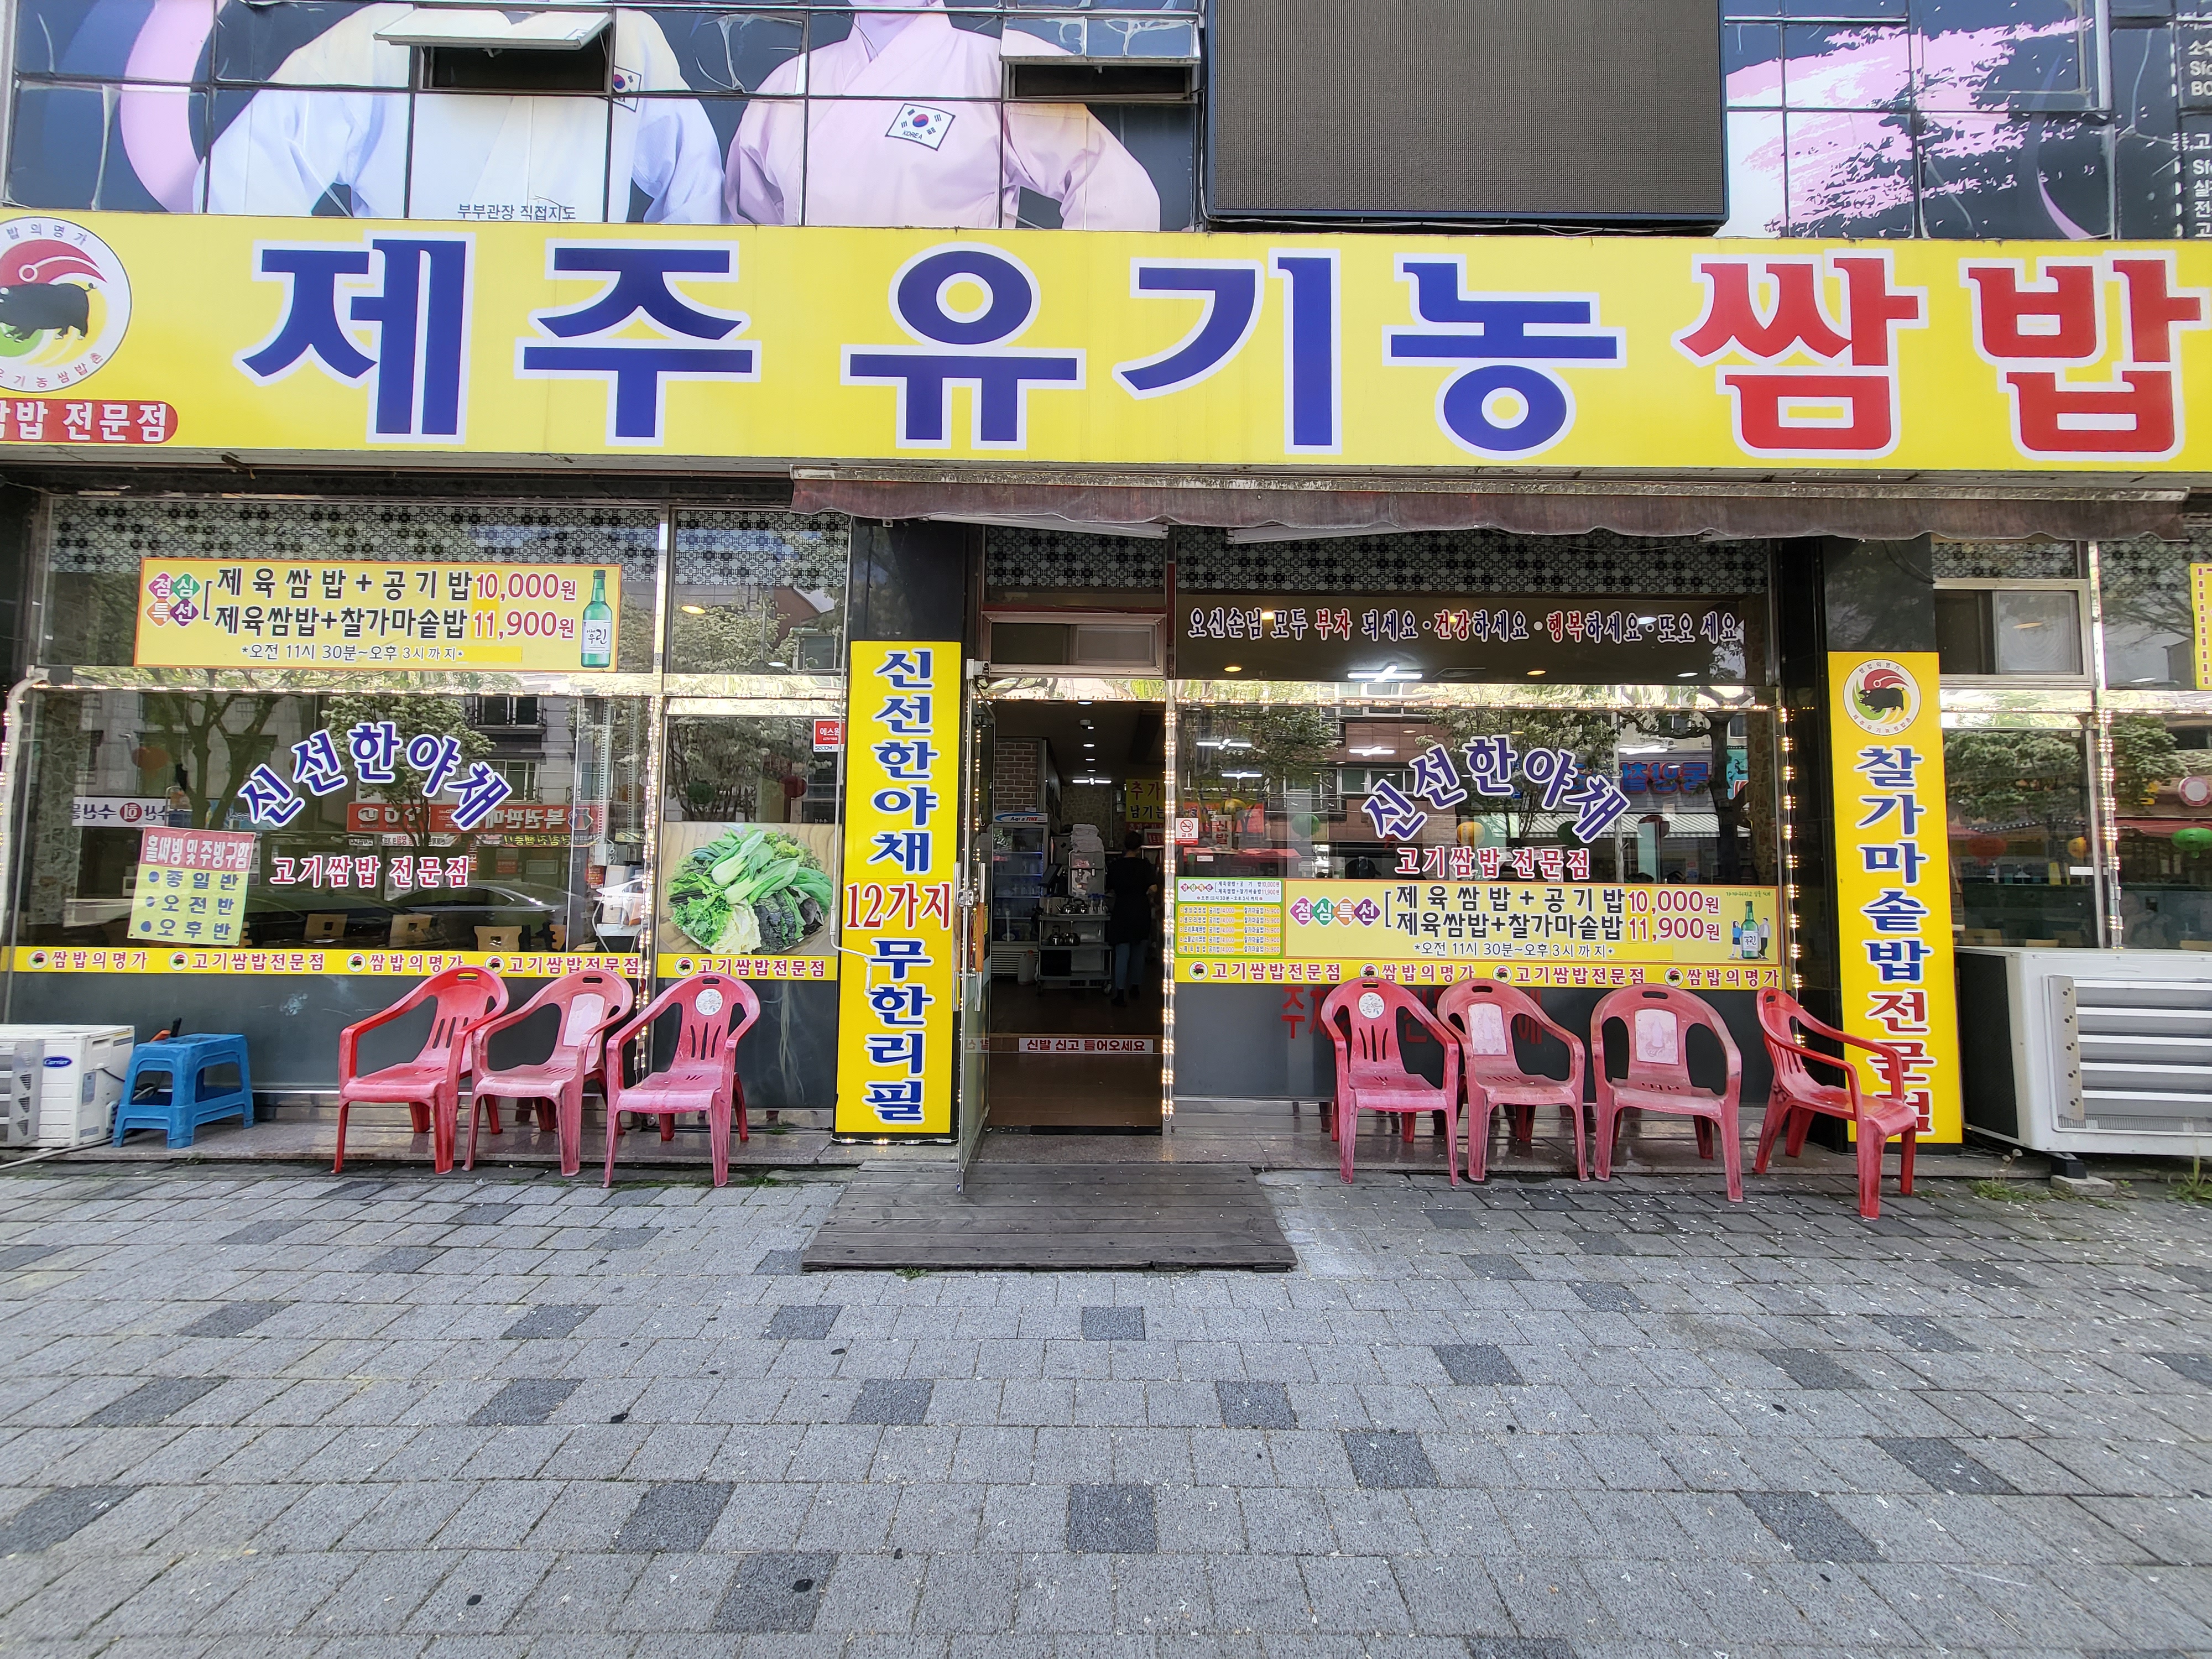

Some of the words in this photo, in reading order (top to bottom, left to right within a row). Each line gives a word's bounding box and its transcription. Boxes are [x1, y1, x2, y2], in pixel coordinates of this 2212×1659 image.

[901, 128, 923, 141] KOREA
[457, 204, 515, 220] 부부관장
[62, 401, 167, 443] 전문점
[1272, 609, 1307, 639] 모두
[1315, 609, 1352, 641] 부자
[286, 645, 315, 660] 11시
[272, 857, 379, 886] 고기쌈밥
[391, 857, 468, 886] 전문점
[1397, 848, 1499, 878] 고기쌈밥
[1515, 849, 1588, 879] 전문점
[1856, 748, 1931, 982] 찰가마솥밥
[847, 883, 950, 928] 12가지
[1452, 942, 1477, 956] 11시
[864, 940, 933, 1121] 무한리필
[1026, 1039, 1051, 1051] 신발
[1055, 1039, 1080, 1051] 신고
[1083, 1039, 1145, 1051] 들어오세요
[44, 1058, 70, 1066] Carrier
